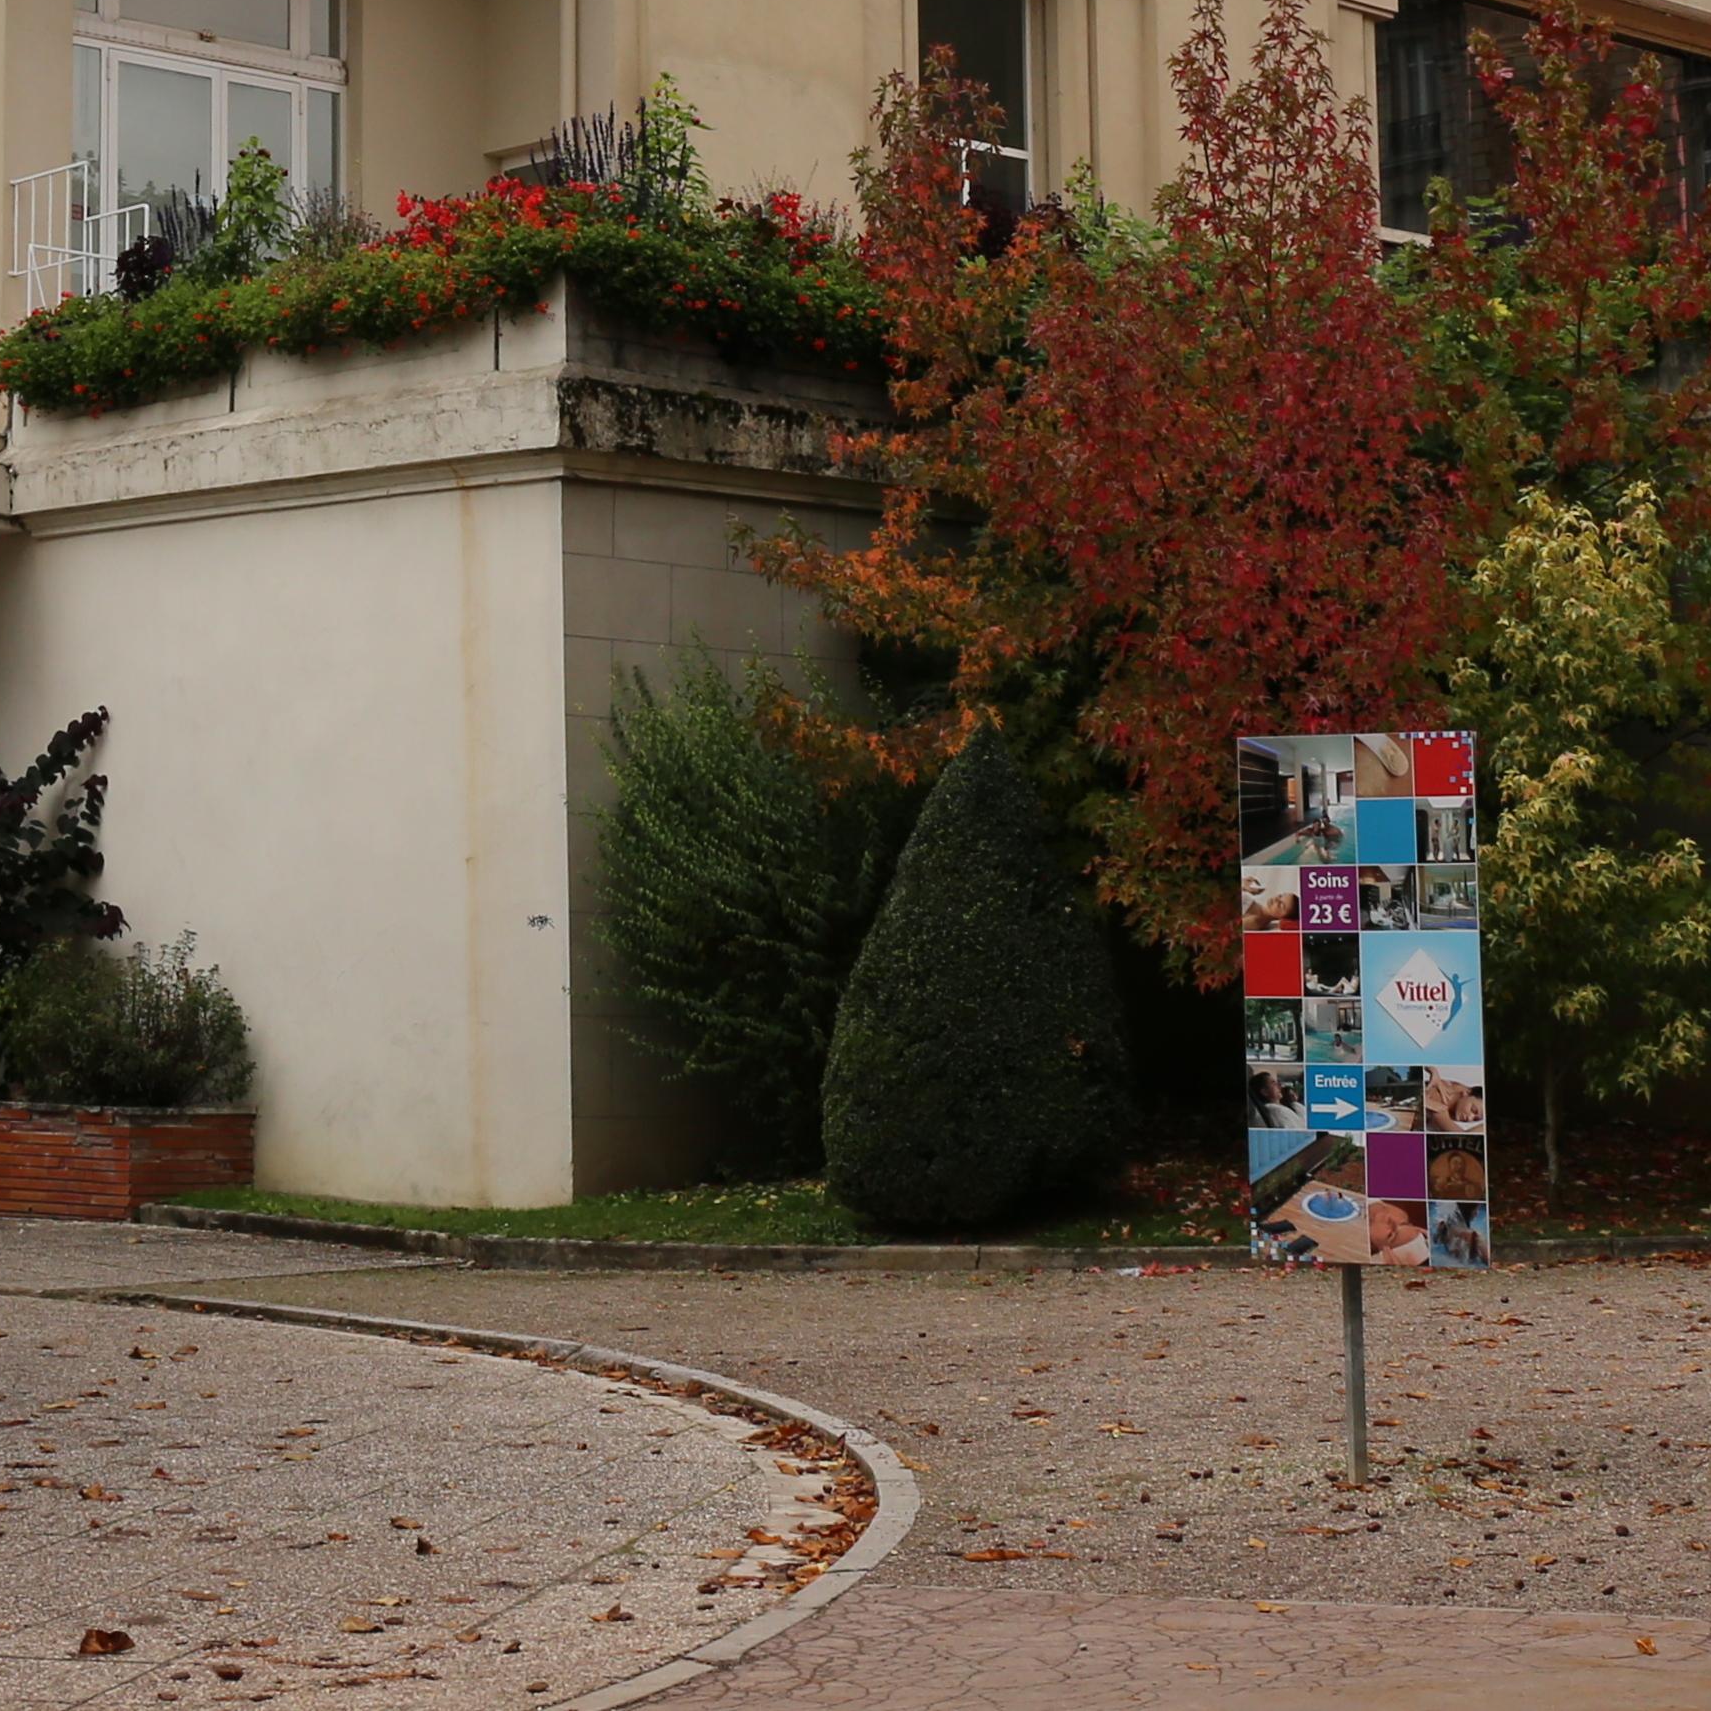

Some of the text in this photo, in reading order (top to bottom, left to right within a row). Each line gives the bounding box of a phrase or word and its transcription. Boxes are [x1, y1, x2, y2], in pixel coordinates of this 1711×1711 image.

[1308, 871, 1349, 888] Soins
[1309, 903, 1352, 924] 23 €
[1395, 981, 1447, 1002] Vittel
[1314, 1073, 1358, 1089] Entrée
